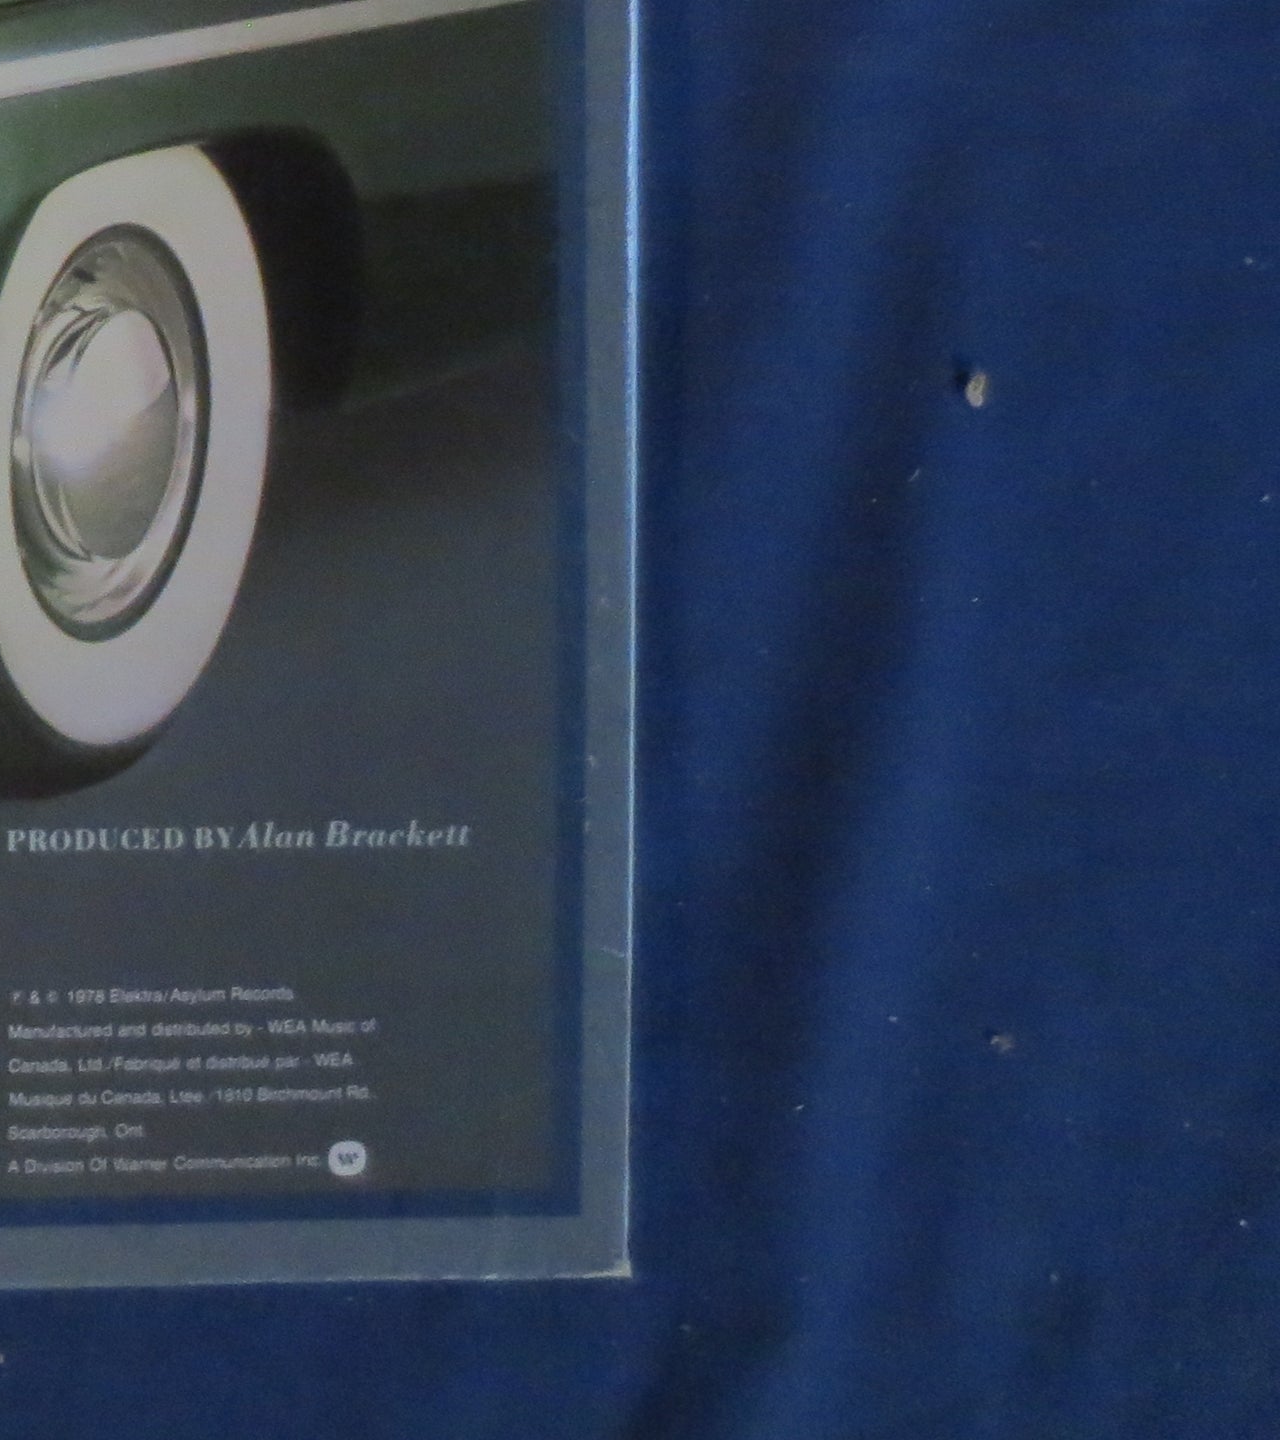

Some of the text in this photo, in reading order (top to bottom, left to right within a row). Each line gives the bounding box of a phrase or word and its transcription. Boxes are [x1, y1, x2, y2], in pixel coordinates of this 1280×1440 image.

[6, 819, 472, 852] PRODUCED BY Alan Brackett
[67, 988, 105, 1005] 1978
[230, 985, 294, 1002] Records
[8, 1024, 113, 1039] Manufactured
[117, 1023, 146, 1038] and
[267, 1019, 307, 1034] WEA
[313, 1052, 354, 1067] WEA
[7, 1159, 20, 1174] A
[24, 1158, 85, 1174] Division
